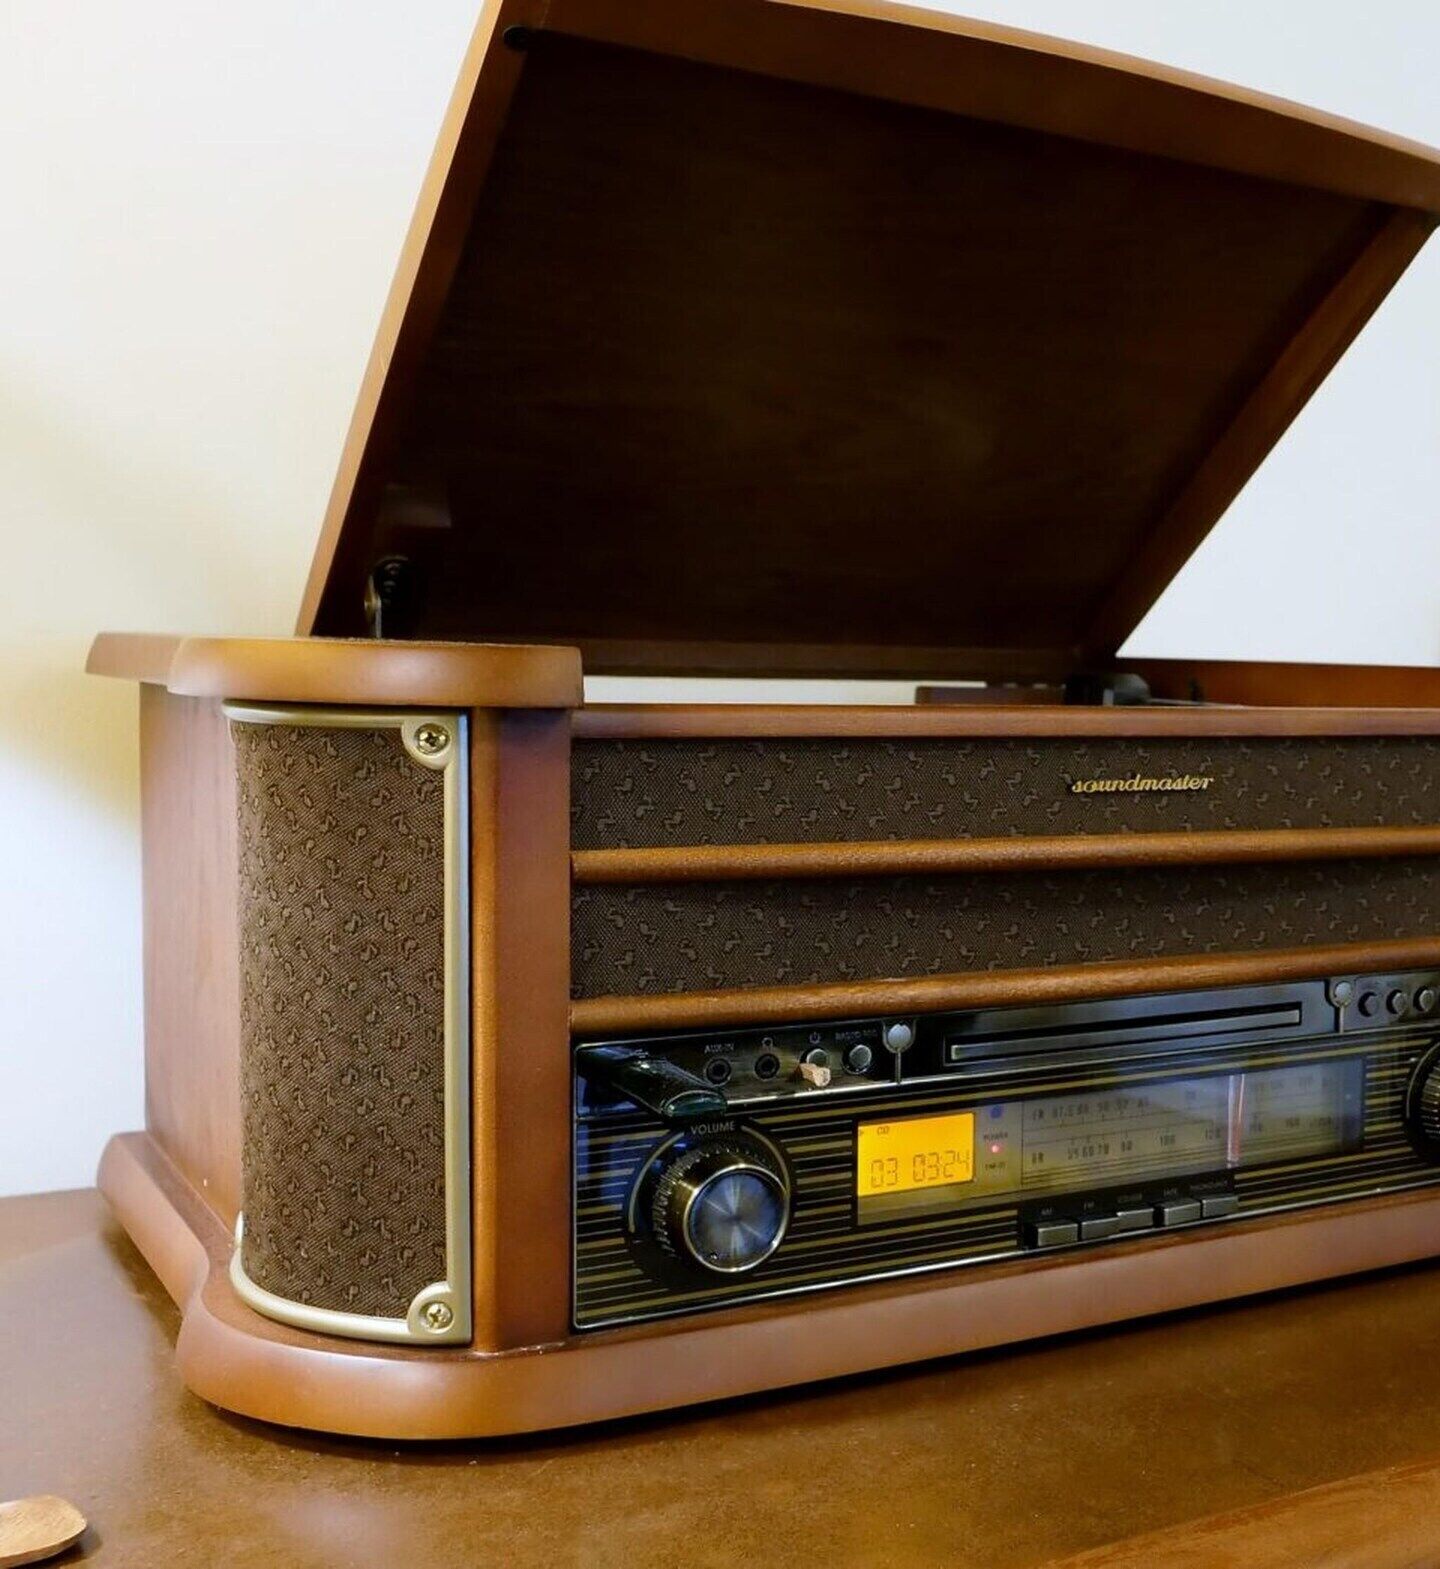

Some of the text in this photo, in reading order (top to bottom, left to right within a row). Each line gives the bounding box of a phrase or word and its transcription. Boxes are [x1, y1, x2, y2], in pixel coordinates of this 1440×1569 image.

[1072, 774, 1214, 793] soundmaster
[690, 1121, 735, 1135] VOLUME
[870, 1157, 899, 1188] 03
